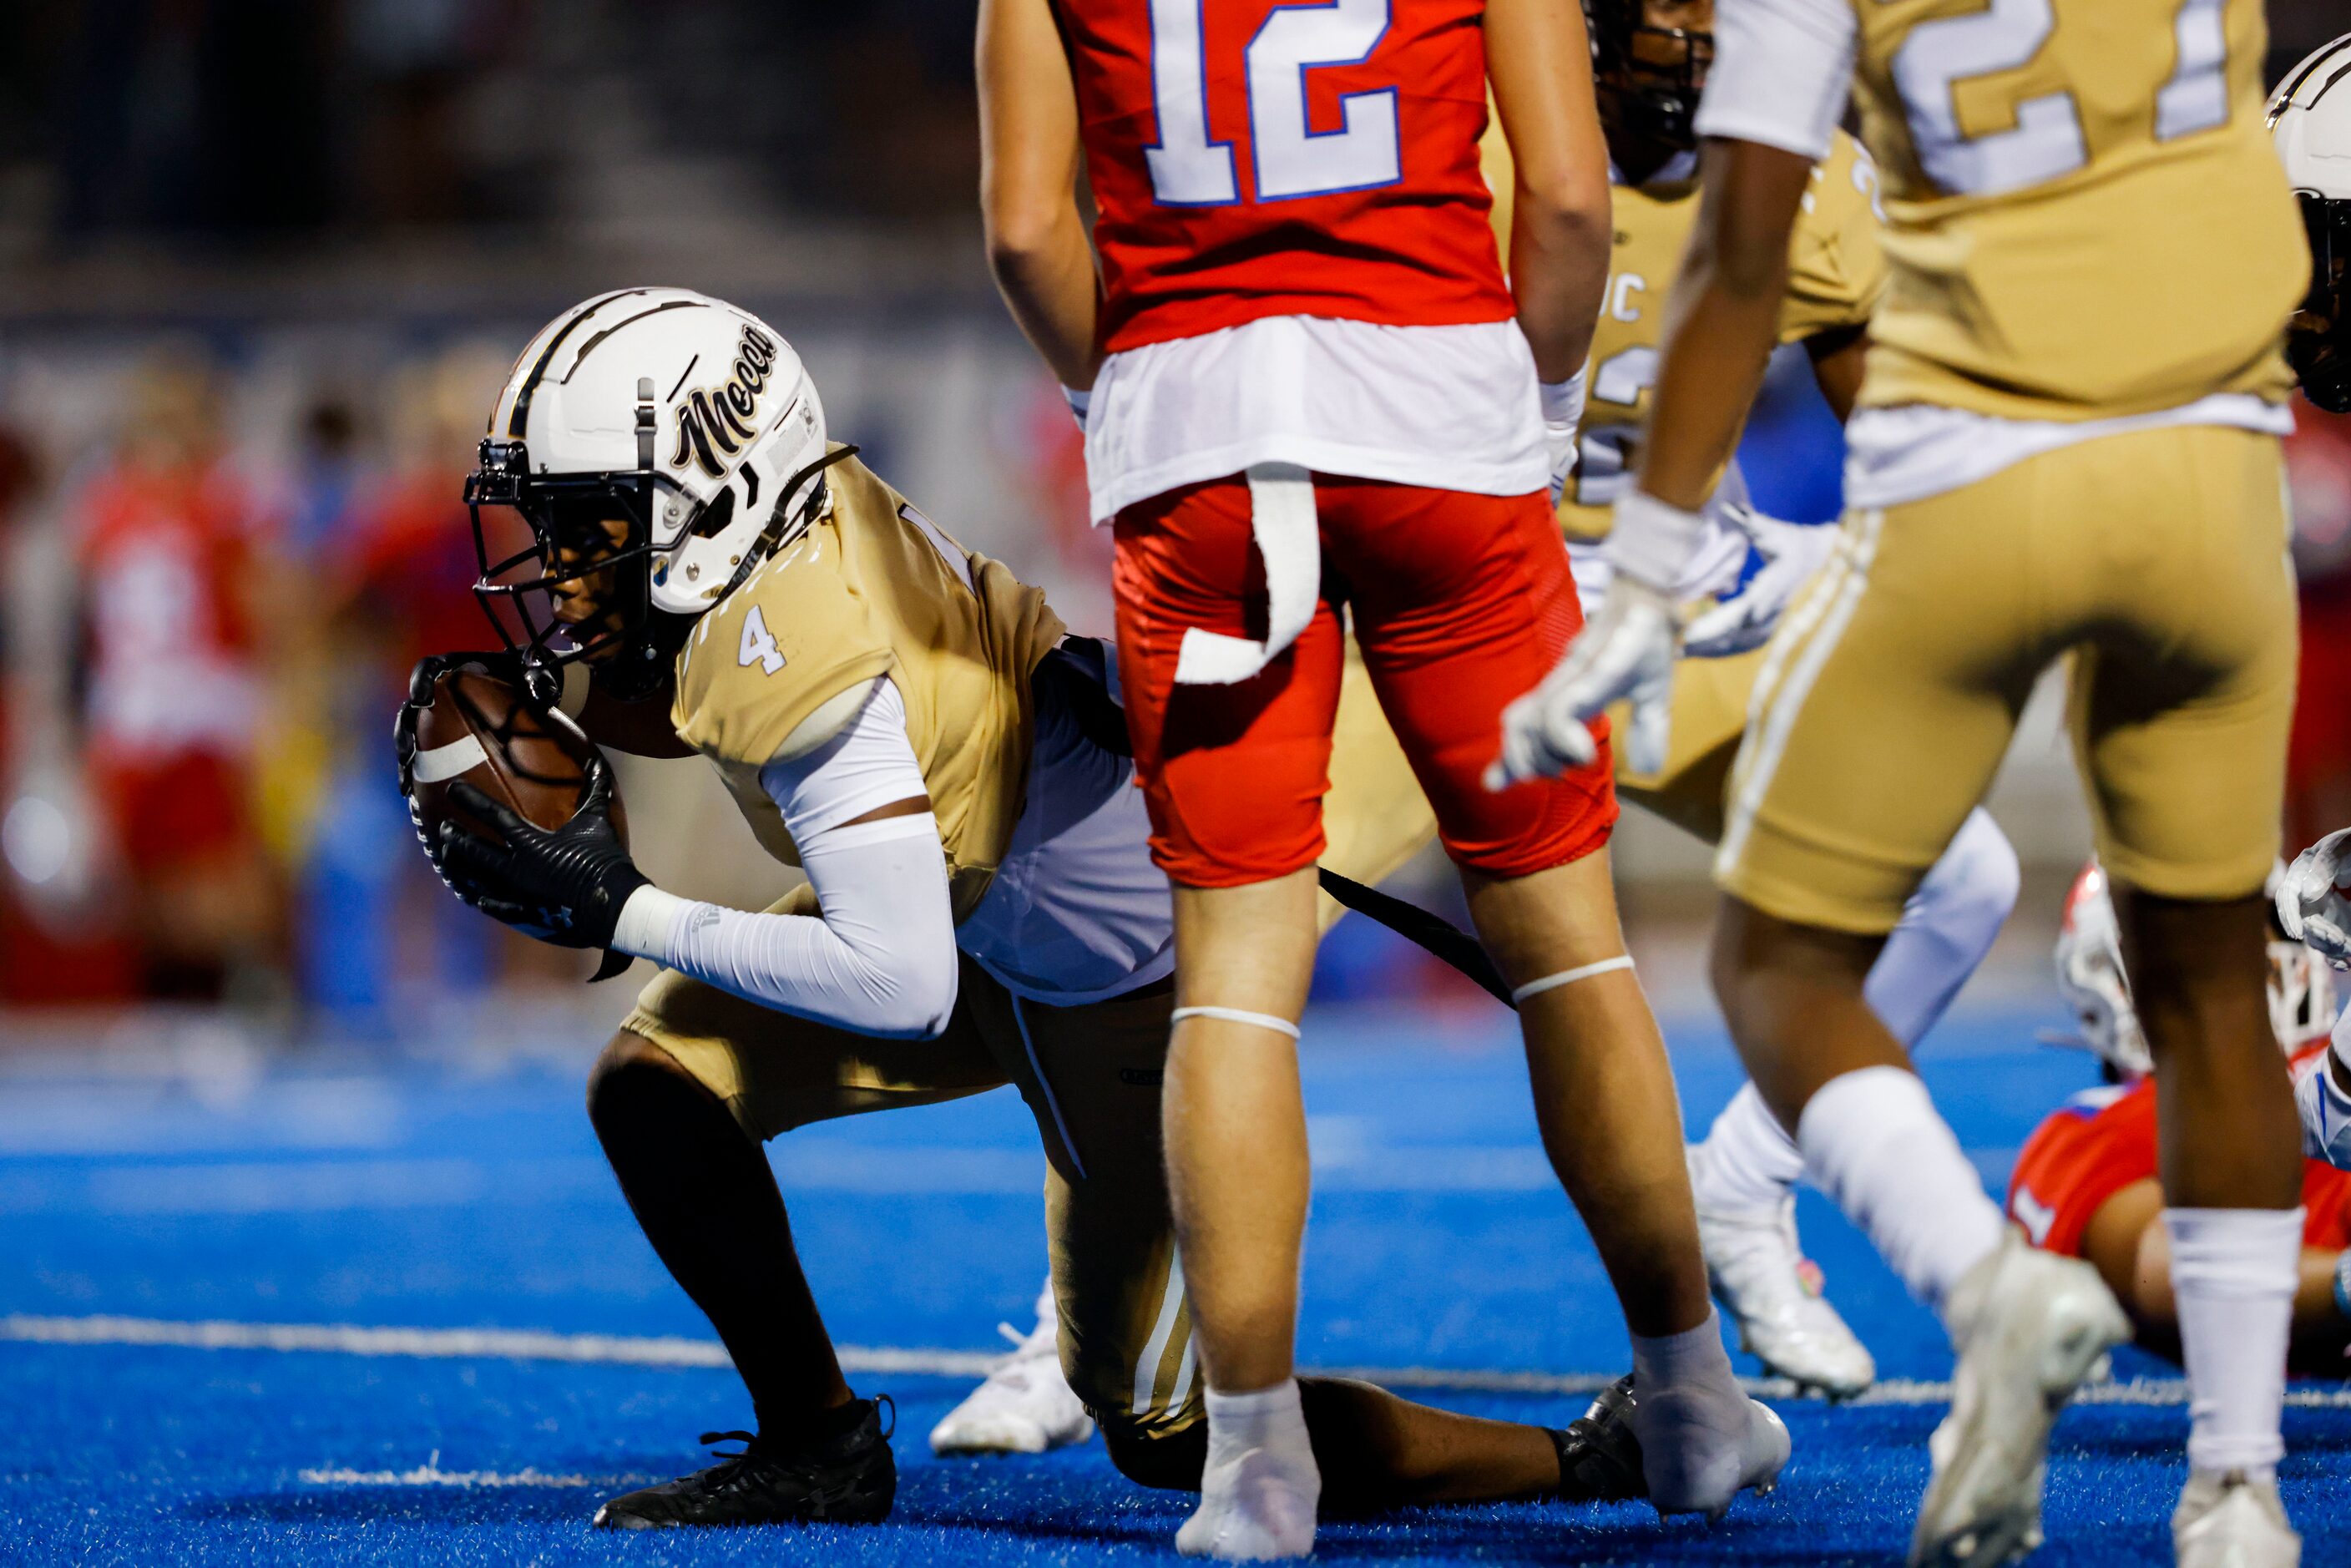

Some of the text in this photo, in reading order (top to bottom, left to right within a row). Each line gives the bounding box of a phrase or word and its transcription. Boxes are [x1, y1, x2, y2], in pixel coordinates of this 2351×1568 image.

[1141, 0, 1403, 207] 12
[670, 323, 777, 481] Mecca
[737, 604, 787, 677] 4
